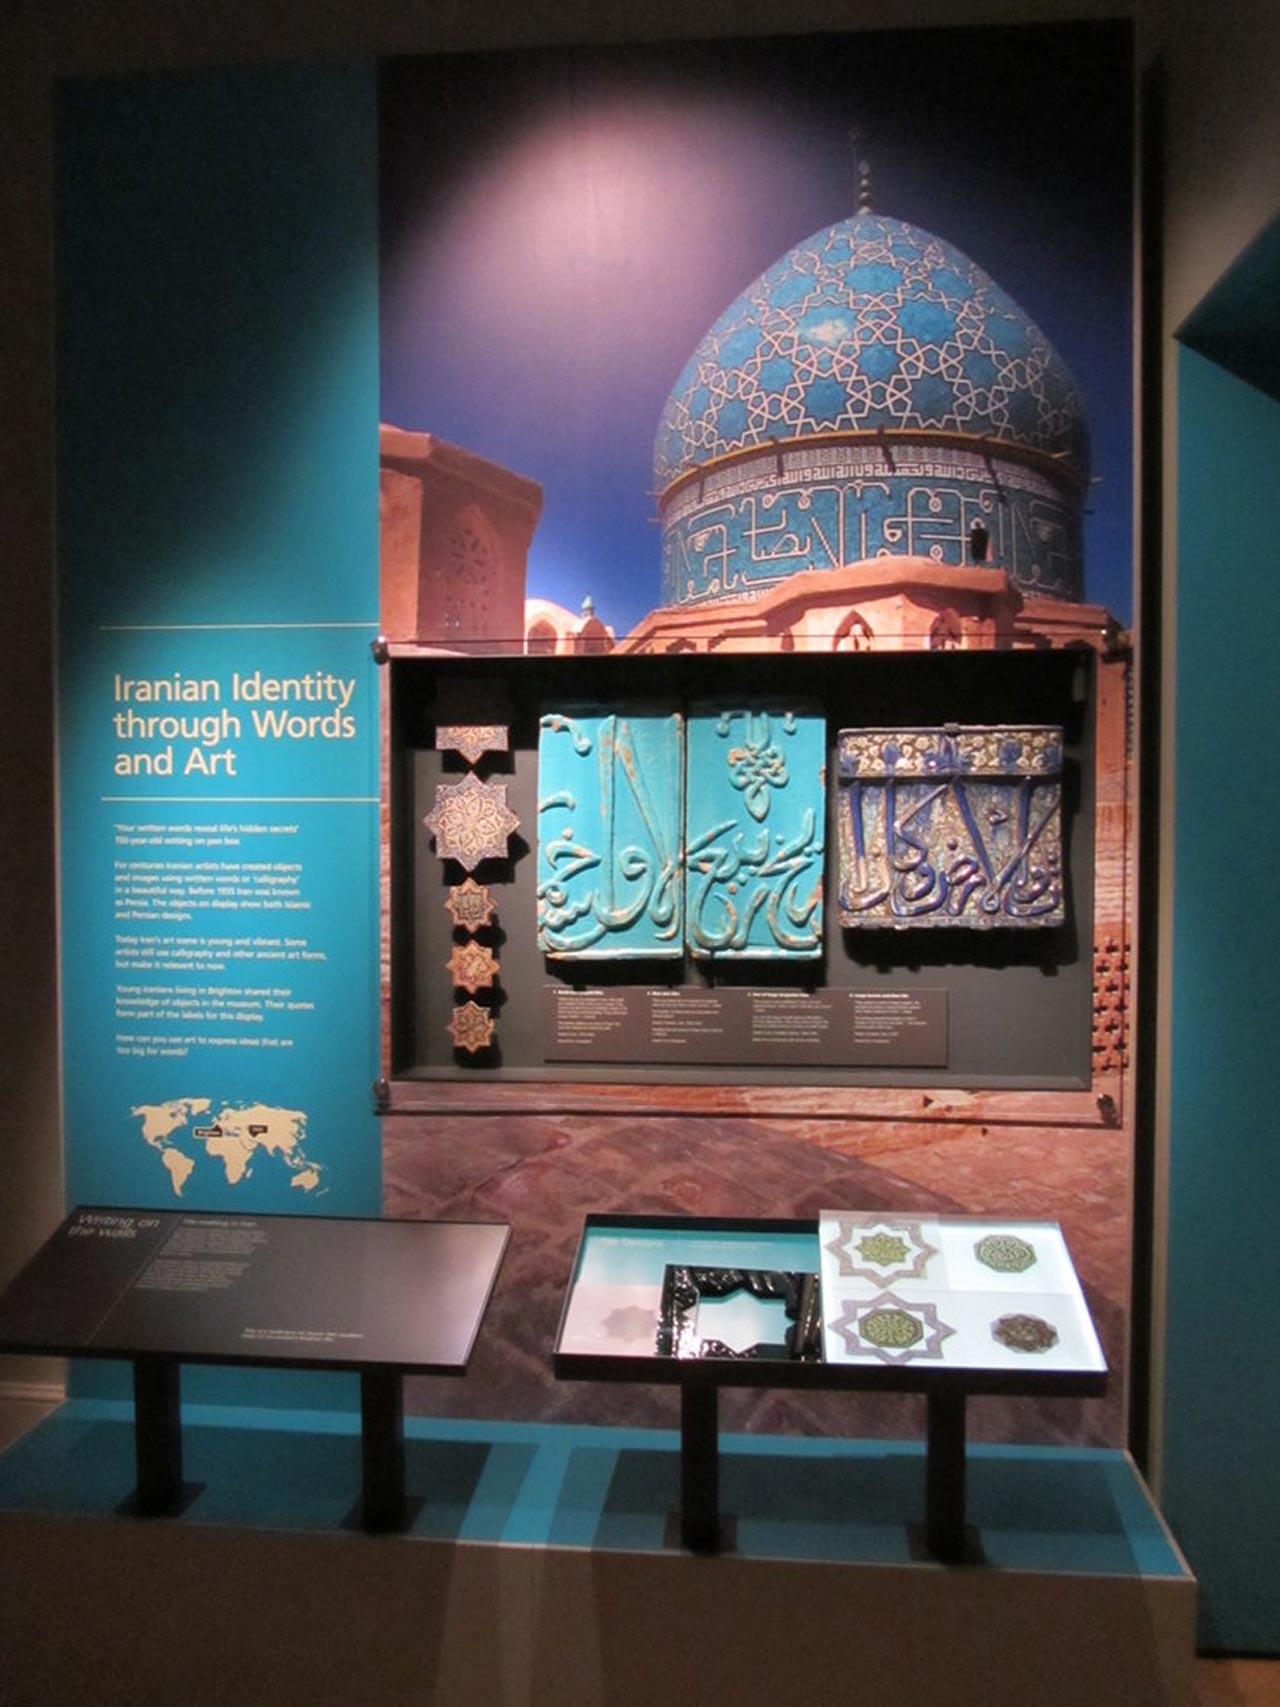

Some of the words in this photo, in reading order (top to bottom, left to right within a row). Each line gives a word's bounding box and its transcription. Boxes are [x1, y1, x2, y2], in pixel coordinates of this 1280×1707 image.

[114, 673, 220, 702] Iranian
[233, 672, 356, 708] Identity
[113, 709, 240, 745] through
[252, 708, 356, 739] Words
[114, 746, 172, 775] and
[184, 747, 236, 775] Art
